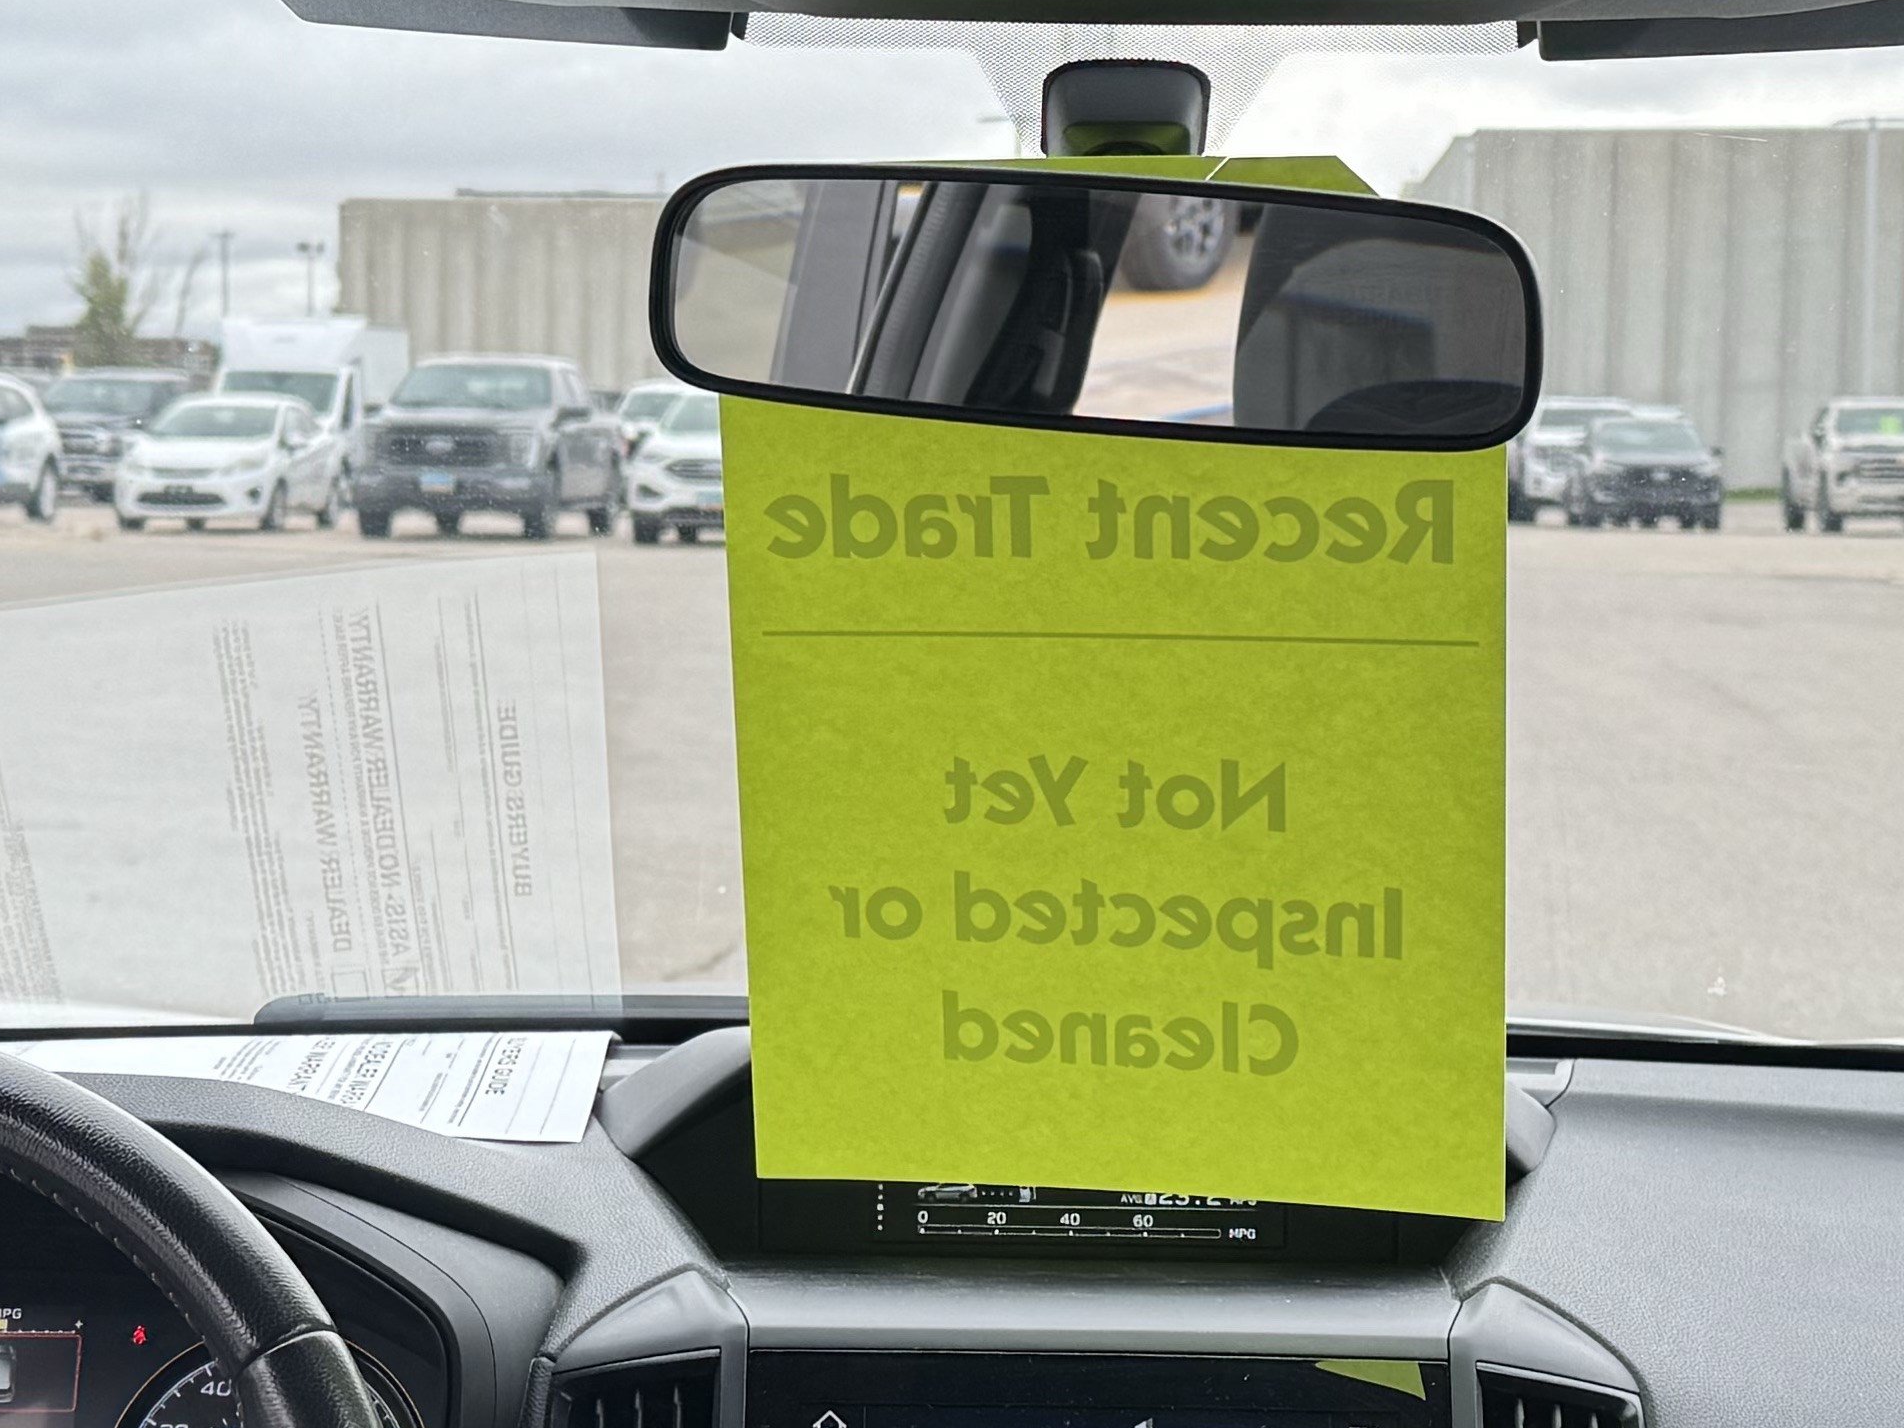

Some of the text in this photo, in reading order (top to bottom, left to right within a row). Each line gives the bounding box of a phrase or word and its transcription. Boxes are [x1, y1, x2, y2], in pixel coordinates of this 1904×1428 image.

[917, 1210, 1154, 1228] 0 20 40 60
[1228, 1228, 1257, 1241] MPG
